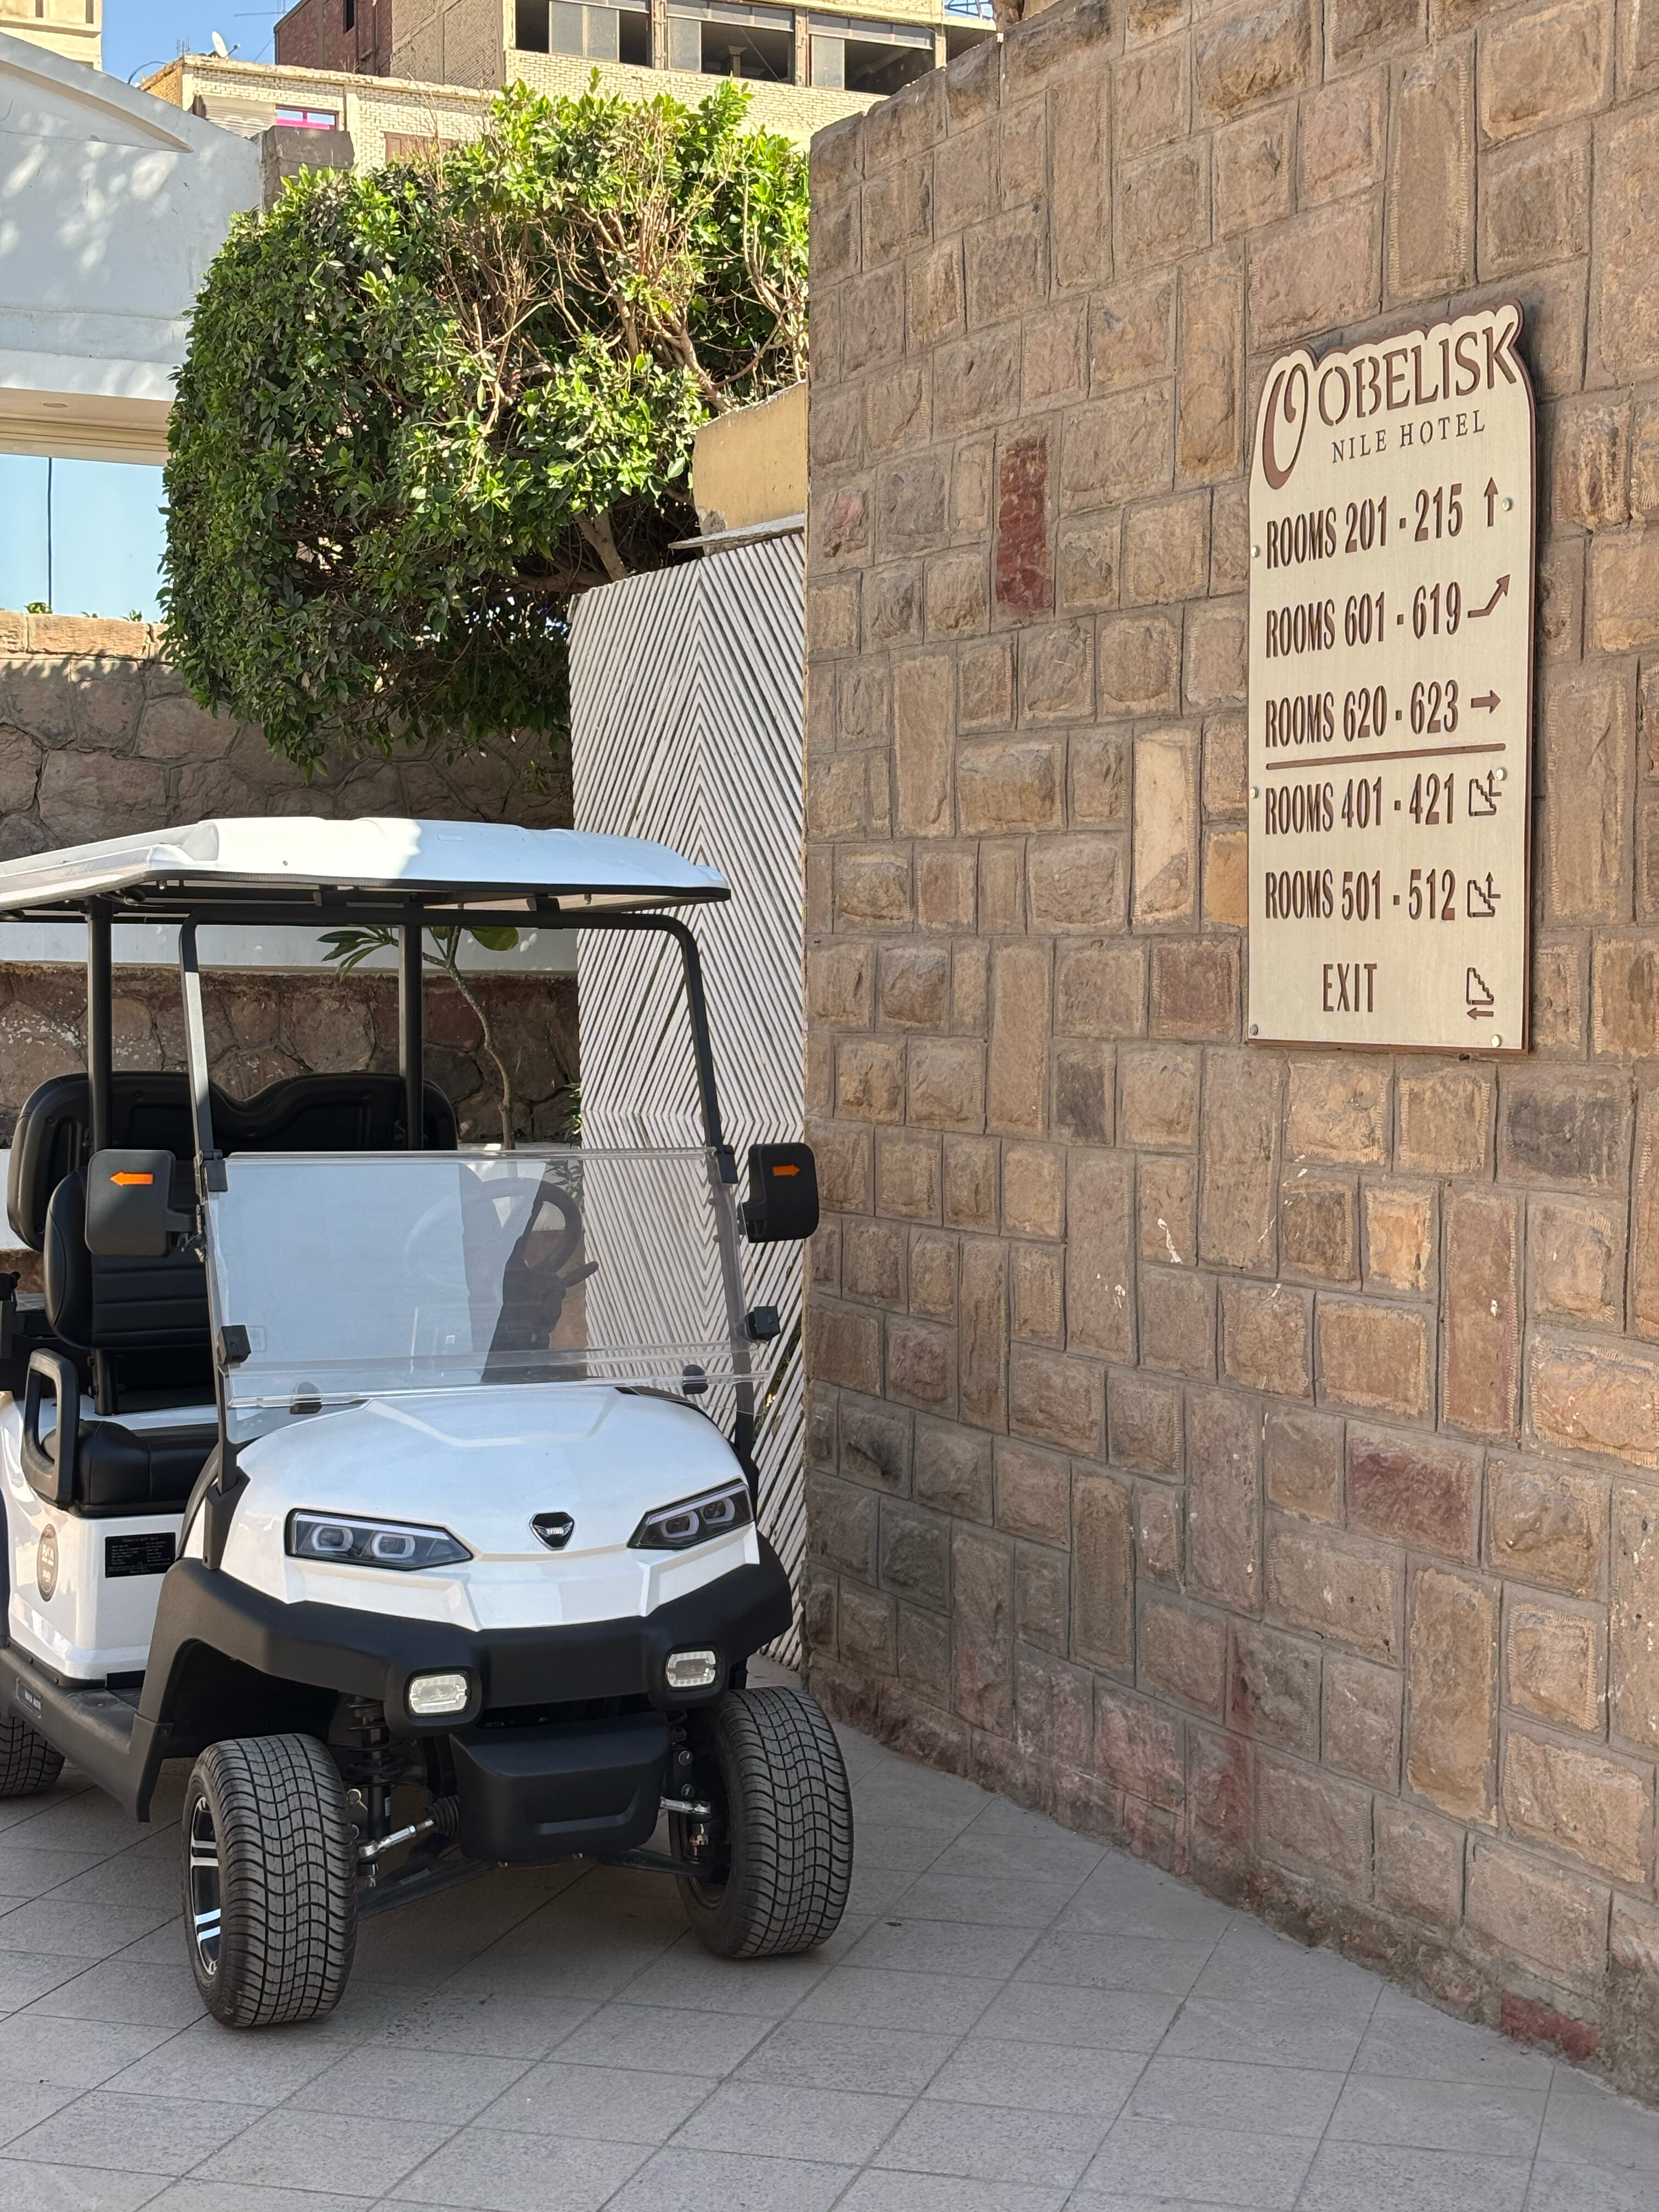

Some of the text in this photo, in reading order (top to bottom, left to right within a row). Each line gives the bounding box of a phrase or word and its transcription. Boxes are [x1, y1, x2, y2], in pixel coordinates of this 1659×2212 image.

[1318, 321, 1517, 426] OBELISK
[1332, 410, 1485, 464] NILE HOTEL
[1267, 507, 1336, 569] ROOMS
[1345, 495, 1386, 554] 201
[1414, 483, 1463, 542] 215
[1266, 599, 1335, 658] ROOMS
[1345, 591, 1384, 647] 601
[1413, 582, 1461, 640] 619
[1266, 692, 1334, 748] ROOMS
[1344, 685, 1387, 742] 620
[1410, 680, 1458, 735] 623
[1266, 782, 1334, 835] ROOMS
[1341, 776, 1381, 828] 401
[1409, 773, 1454, 825] 421
[1266, 869, 1333, 919] ROOMS
[1342, 870, 1380, 921] 501
[1409, 868, 1455, 921] 512
[1323, 963, 1377, 1013] EXIT
